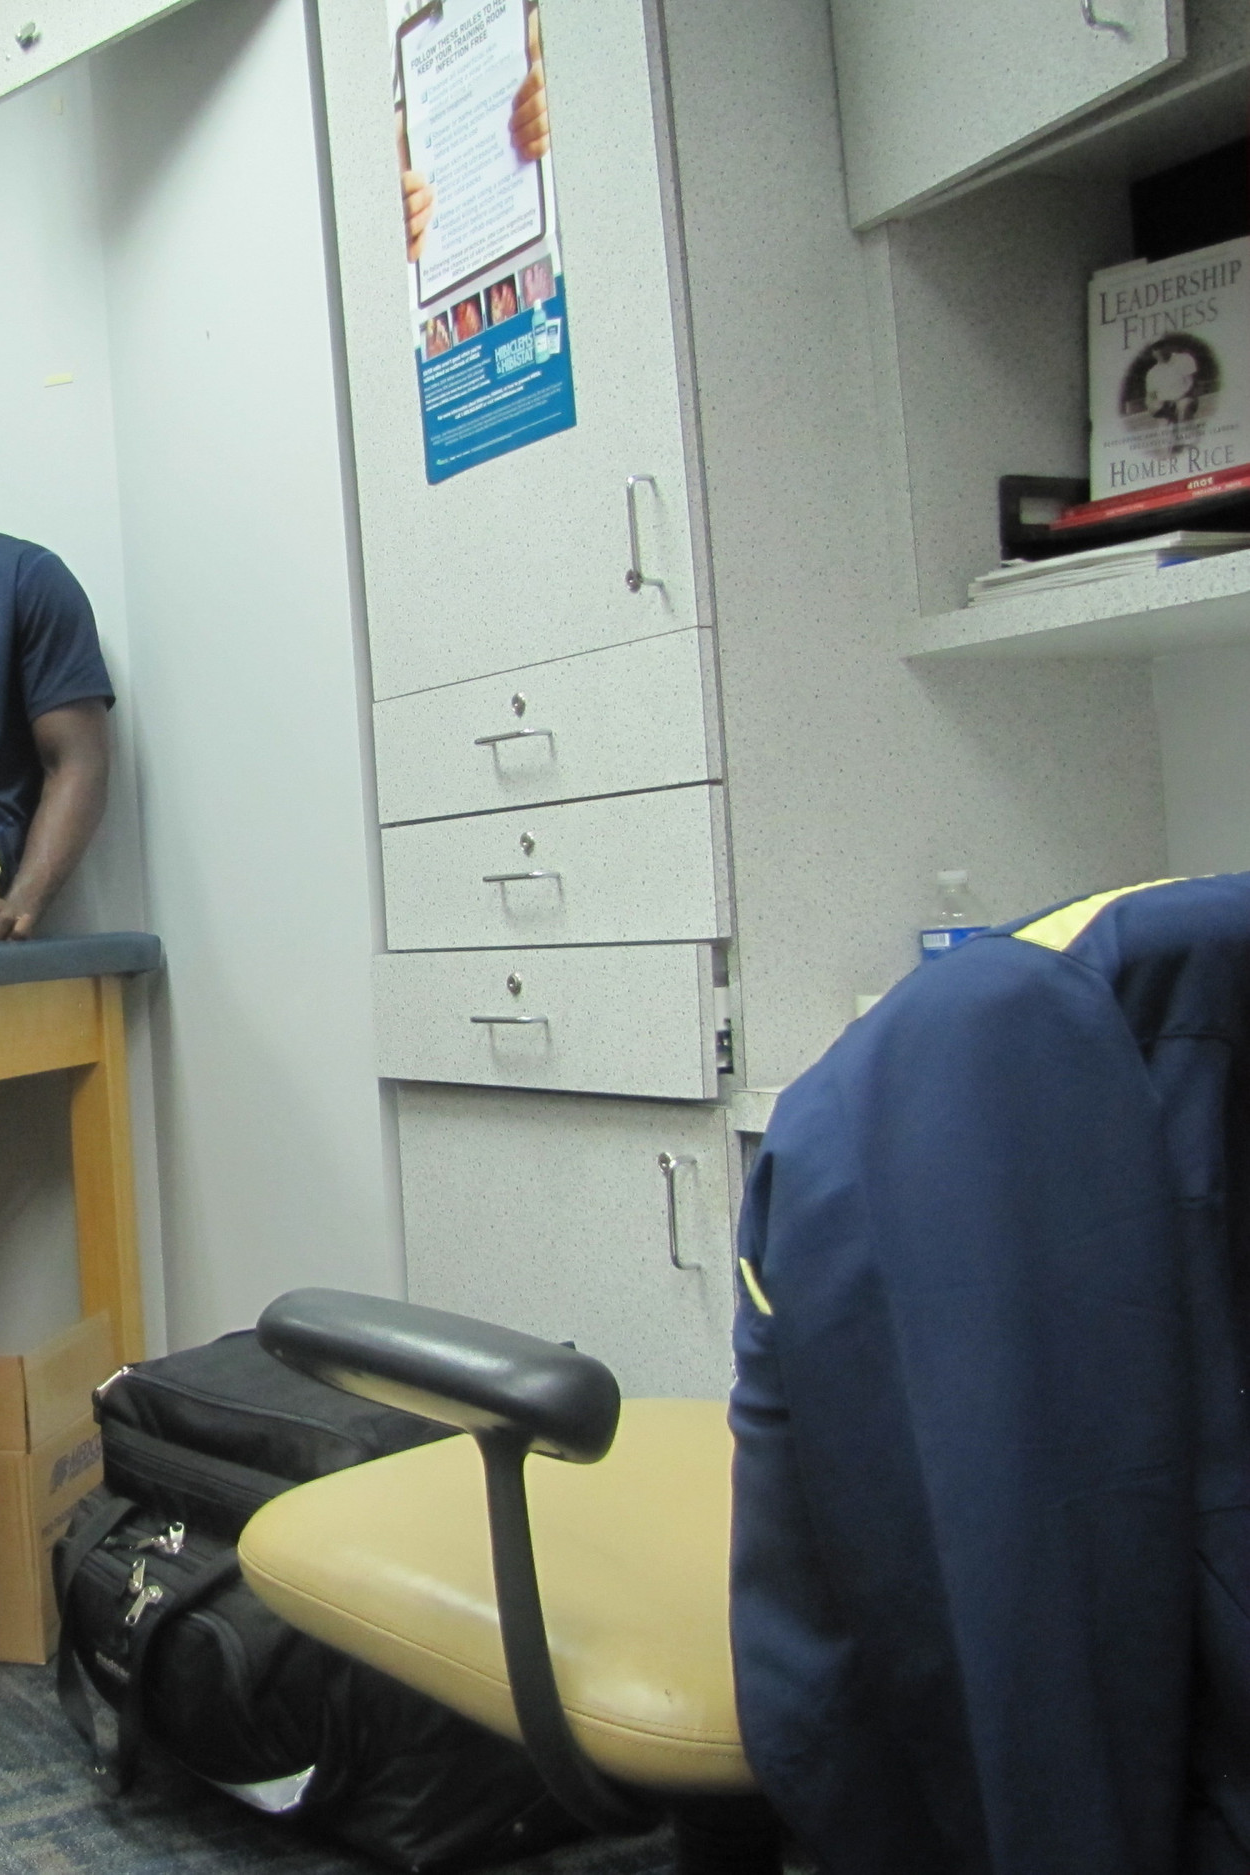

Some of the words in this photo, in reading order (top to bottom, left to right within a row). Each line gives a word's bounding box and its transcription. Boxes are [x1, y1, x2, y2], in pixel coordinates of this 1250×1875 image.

[410, 42, 437, 70] FOLLOW
[437, 26, 458, 51] THESE
[459, 9, 481, 34] RULES
[482, 4, 491, 16] TO
[417, 57, 433, 77] KEEP
[435, 43, 452, 63] YOUR
[453, 19, 484, 50] TRAINING
[485, 3, 506, 26] ROOM
[435, 42, 469, 74] INFECTION
[470, 28, 487, 49] FREE
[1099, 260, 1242, 326] LEADERSHIP
[1124, 297, 1218, 350] FITNESS
[1110, 455, 1178, 488] HOMER
[1188, 444, 1235, 473] RICE
